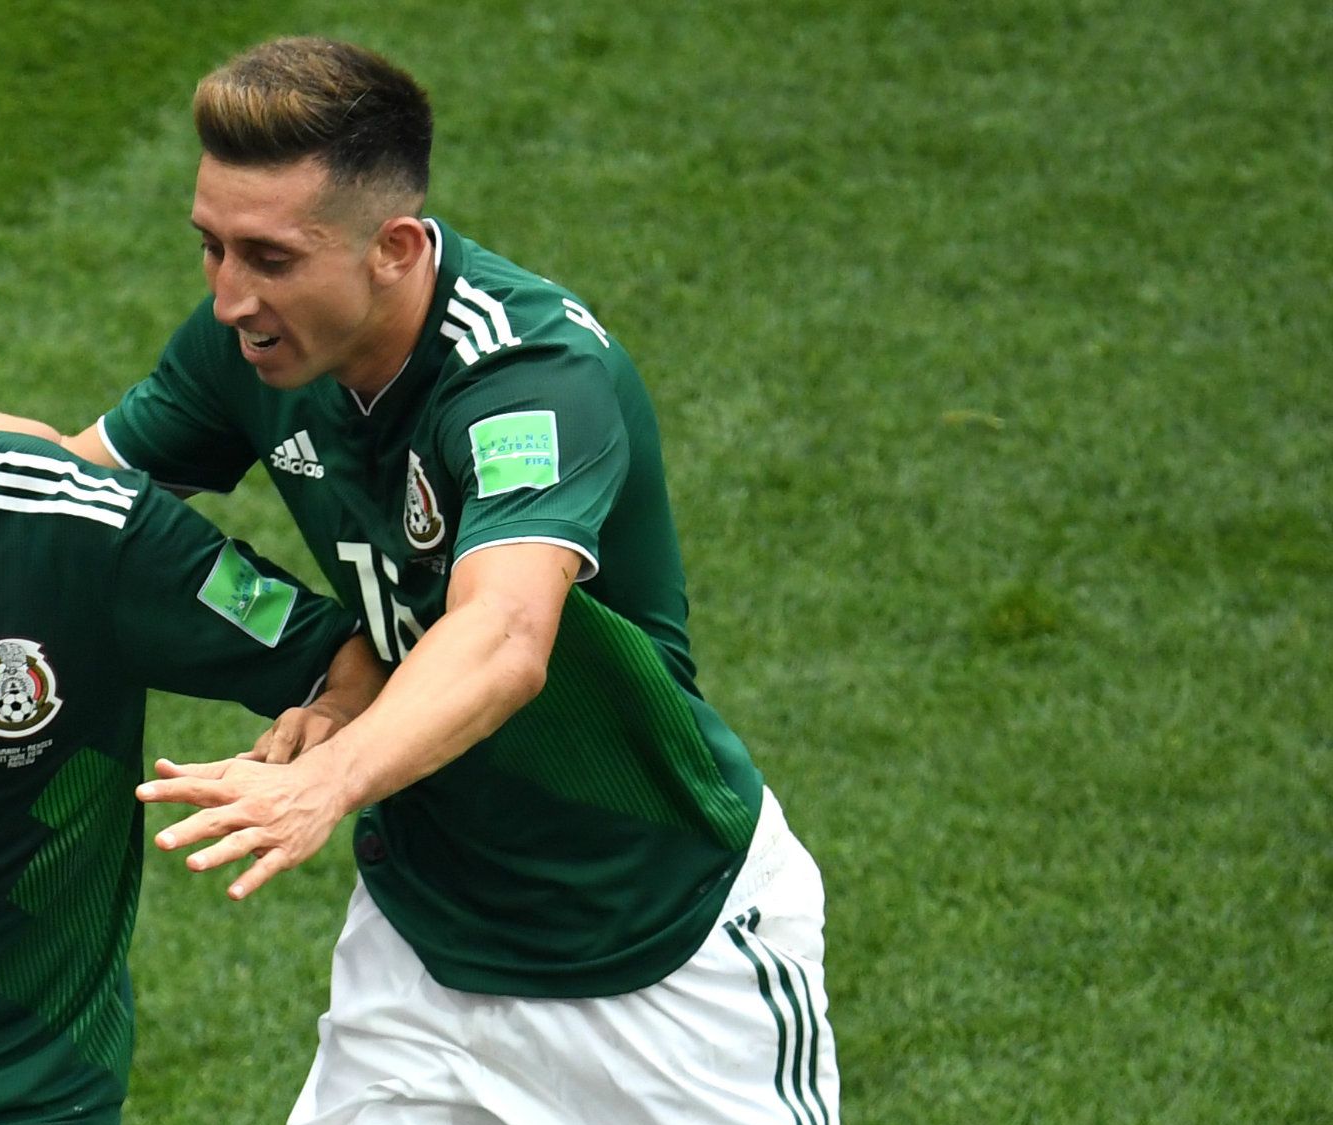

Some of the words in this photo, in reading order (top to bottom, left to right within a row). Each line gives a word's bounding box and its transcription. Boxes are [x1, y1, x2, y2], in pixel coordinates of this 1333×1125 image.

[479, 434, 549, 452] LIVING
[269, 453, 325, 479] adidas
[525, 457, 552, 467] FIFA
